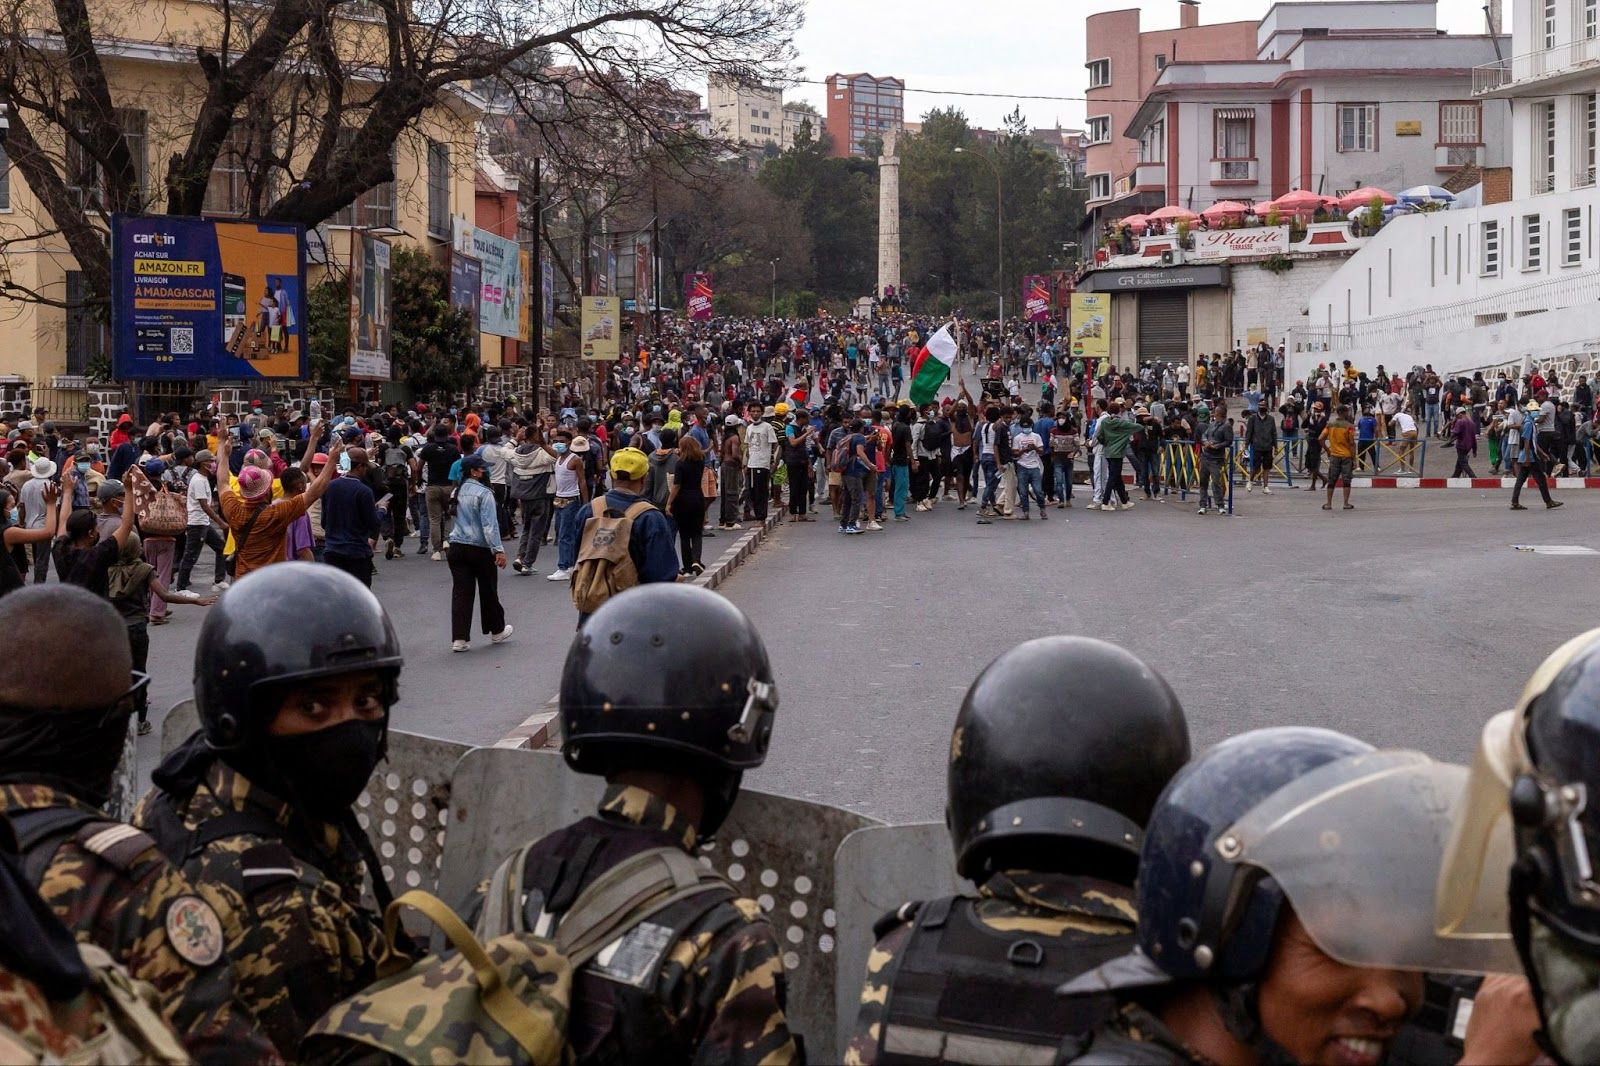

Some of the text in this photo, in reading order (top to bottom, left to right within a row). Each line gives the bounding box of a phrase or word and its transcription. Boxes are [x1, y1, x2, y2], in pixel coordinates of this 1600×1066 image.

[1207, 230, 1280, 246] Planète
[139, 262, 200, 274] AMAZON.FR
[134, 276, 169, 284] LIVRAISON
[1118, 276, 1135, 286] GR
[134, 284, 216, 298] À MADAGASCAR
